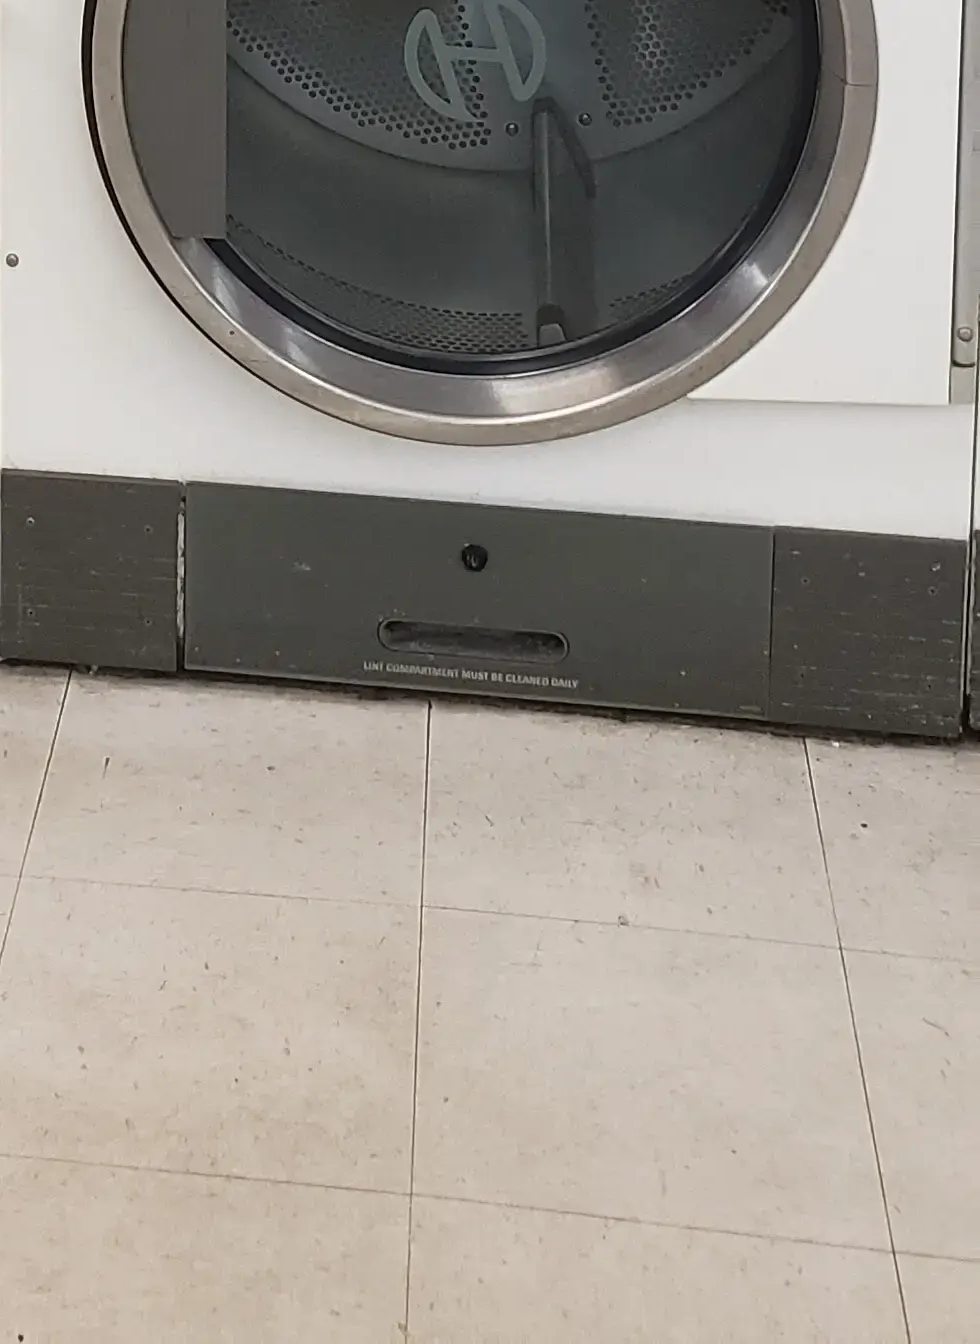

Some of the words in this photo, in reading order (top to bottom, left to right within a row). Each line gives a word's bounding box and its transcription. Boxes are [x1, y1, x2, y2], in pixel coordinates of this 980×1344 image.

[363, 660, 384, 672] LINT
[461, 668, 489, 681] MUST
[491, 672, 503, 683] BE
[505, 673, 549, 687] CLEANED
